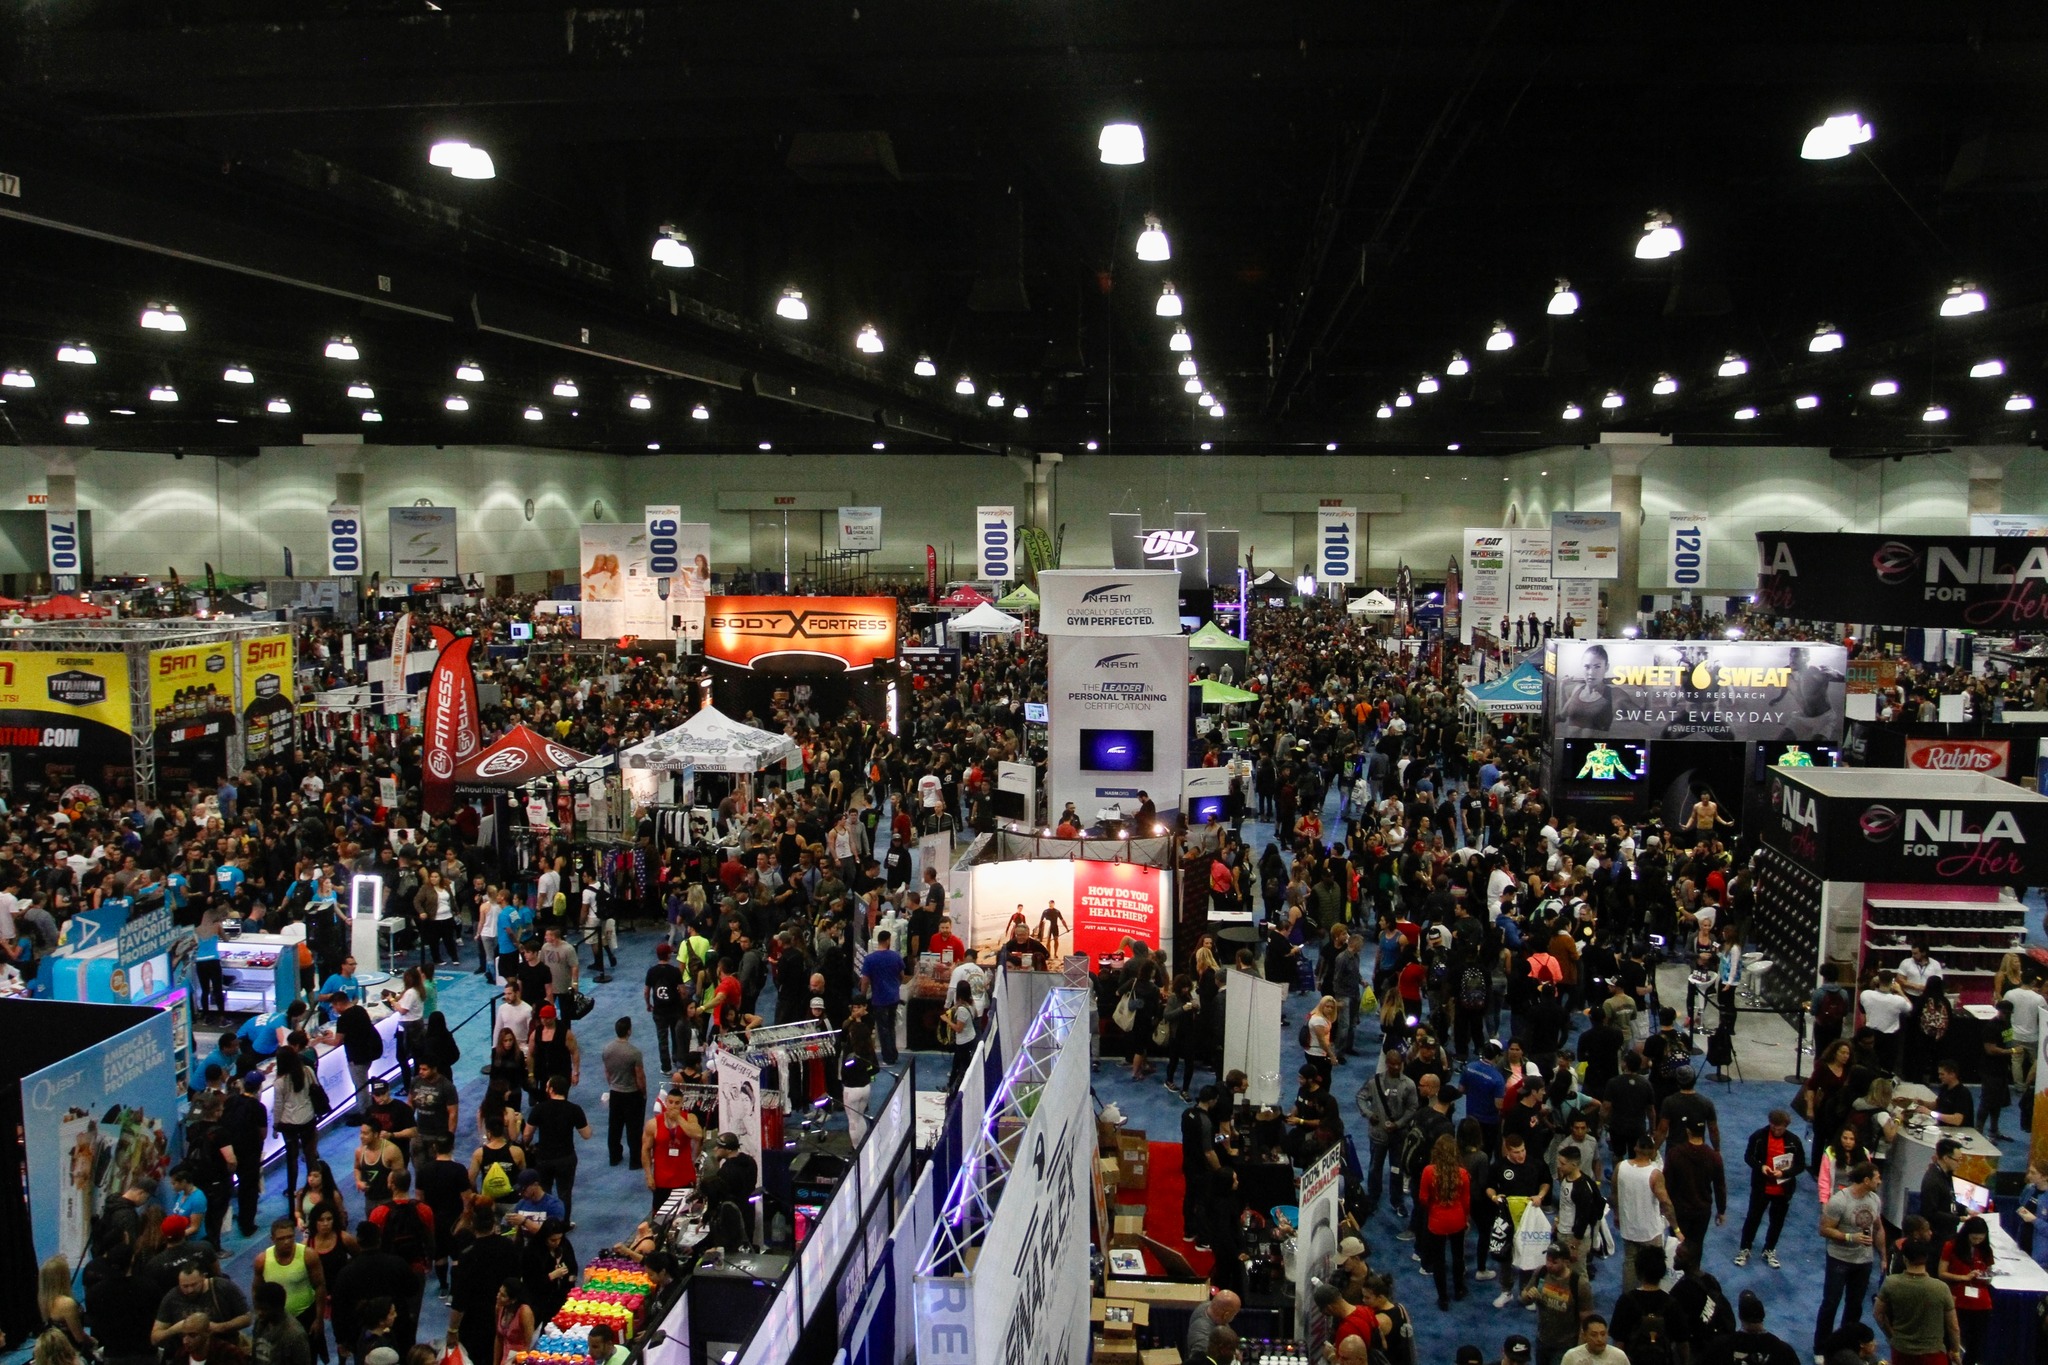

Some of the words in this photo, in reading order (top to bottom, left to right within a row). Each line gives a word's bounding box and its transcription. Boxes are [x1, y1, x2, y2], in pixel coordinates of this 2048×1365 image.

[1320, 499, 1343, 507] EXIT
[51, 521, 76, 568] 700
[331, 519, 359, 571] 800
[650, 519, 678, 573] 900
[984, 519, 1009, 576] 1000
[1143, 530, 1197, 555] ON
[1324, 522, 1350, 576] 1100
[1484, 538, 1503, 546] GAT
[1674, 526, 1701, 583] 1200
[1925, 546, 2048, 584] NLA
[1089, 594, 1131, 602] NASM
[1924, 587, 1967, 601] FOR
[1067, 617, 1089, 626] GYM
[1090, 616, 1154, 626] PERFECTED.
[1109, 608, 1152, 616] DEVELOPED
[711, 618, 783, 629] BODY
[809, 619, 887, 630] FORTRESS
[247, 642, 286, 665] SAN
[159, 654, 197, 675] SAN
[1102, 661, 1139, 669] NASM
[52, 680, 100, 691] TITANIUM
[1612, 666, 1687, 687] SWEET
[1717, 667, 1792, 688] SWEAT
[65, 692, 90, 700] SERIES
[1082, 683, 1100, 691] THE
[1103, 683, 1143, 692] LEADER
[1656, 691, 1699, 699] SPORTS
[1707, 691, 1766, 700] RESEARCH
[1068, 693, 1119, 701] PERSONAL
[1121, 693, 1167, 702] TRAINING
[1084, 703, 1151, 711] CERTIFICATION
[434, 666, 454, 752] FITNESS
[1615, 710, 1676, 722] SWEAT
[1689, 710, 1785, 723] EVERYDAY
[247, 732, 267, 744] BEEF
[1667, 725, 1731, 734] #SWEETSWEAT
[491, 752, 523, 767] 24
[1925, 747, 1992, 771] Ralphs
[1782, 784, 1819, 834] NLA
[1781, 817, 1793, 833] FOR
[1903, 808, 2027, 844] NLA
[1903, 844, 1939, 857] FOR
[1935, 825, 2025, 877] Her
[1088, 886, 1114, 896] HOW
[1115, 887, 1130, 898] DO
[1130, 890, 1149, 902] YOU
[1081, 896, 1115, 908] START
[1116, 899, 1154, 914] FEELING
[120, 908, 169, 938] AMERICA'S
[1089, 907, 1148, 923] HEALTHIER?
[120, 916, 172, 953] FAVORITE
[120, 941, 159, 967] PROTEIN
[104, 1030, 152, 1065] AMERICA'S
[104, 1039, 158, 1083] FAVORITE
[105, 1066, 143, 1096] PROTEIN
[1302, 1165, 1320, 1191] 100%
[1322, 1145, 1340, 1173] PURE
